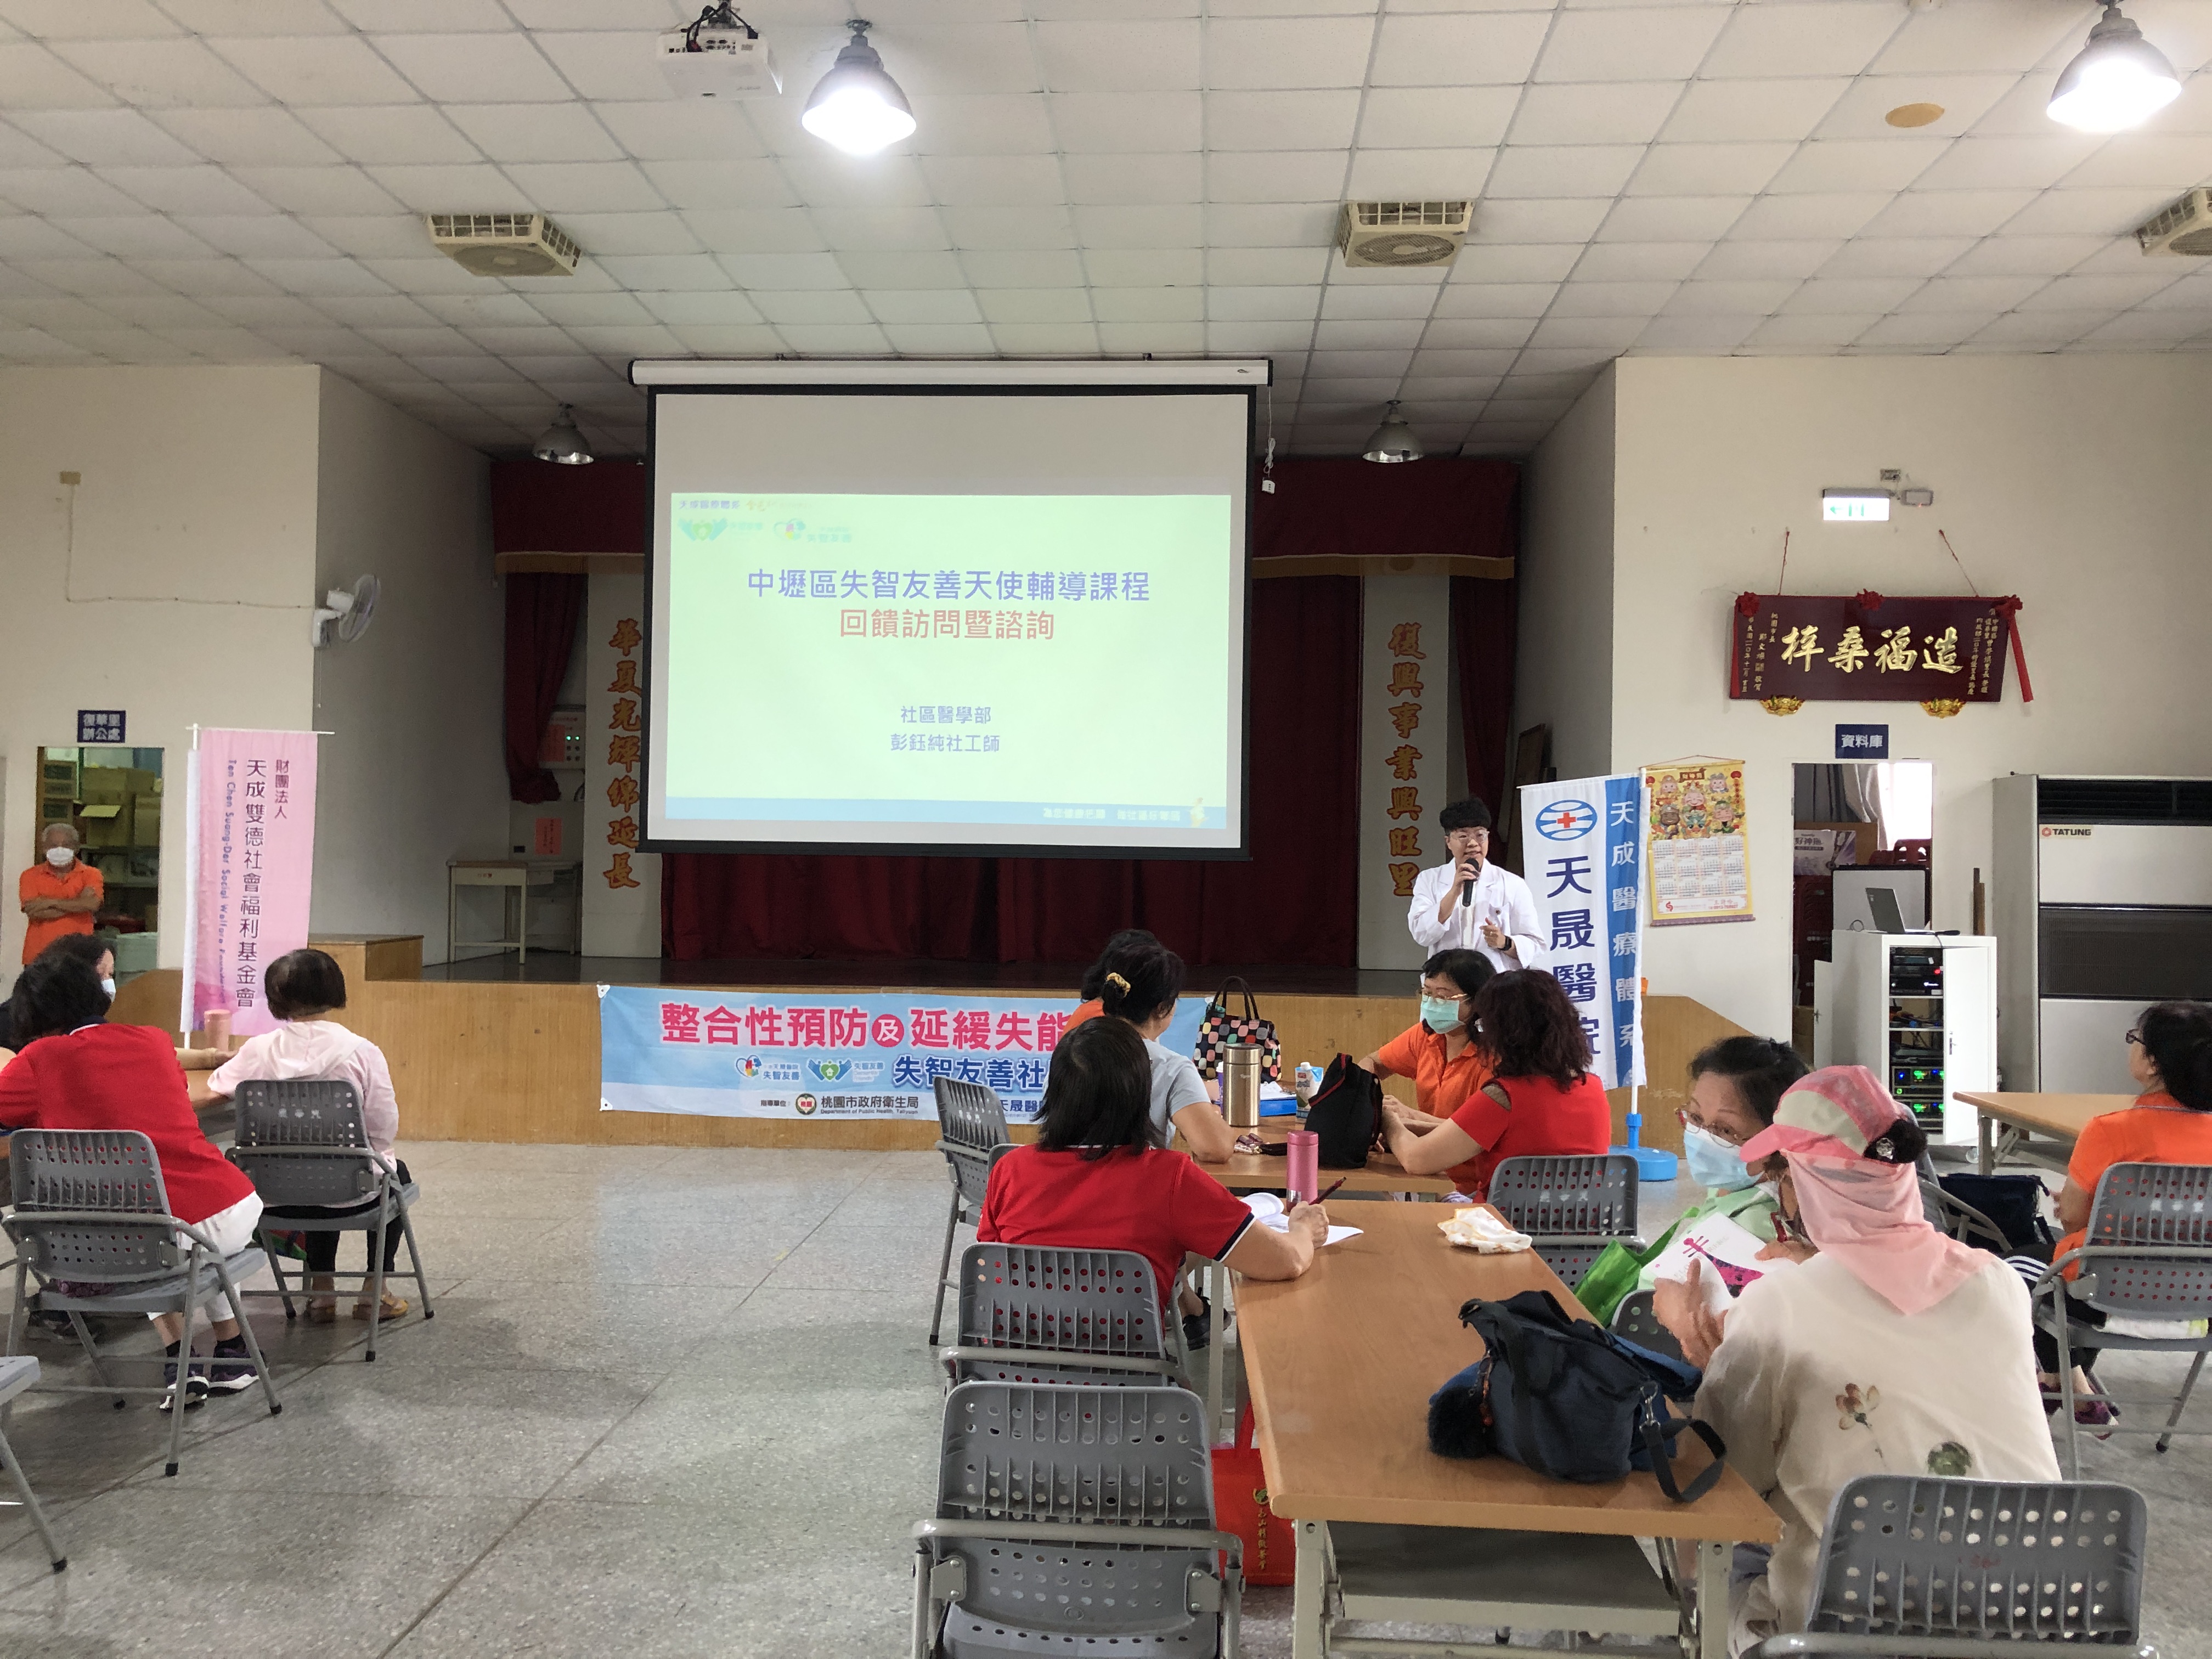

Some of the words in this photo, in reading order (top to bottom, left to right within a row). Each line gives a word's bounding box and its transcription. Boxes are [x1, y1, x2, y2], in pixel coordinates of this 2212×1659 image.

[748, 568, 1150, 601] 中壢區失智友善天使輔導課程
[840, 608, 1054, 640] 回饋訪問暨諮詢
[900, 706, 992, 725] 社區醫學部
[890, 733, 1001, 753] 彭鈺純社工師
[274, 758, 290, 820] 財團法人
[2052, 828, 2092, 837] TATUNG
[235, 758, 267, 1008] 天成雙德社會福利基金會
[763, 1070, 800, 1081] 失智友善
[821, 1096, 919, 1109] 桃園市政府衛生局
[1000, 1099, 1044, 1112] 天晟醫
